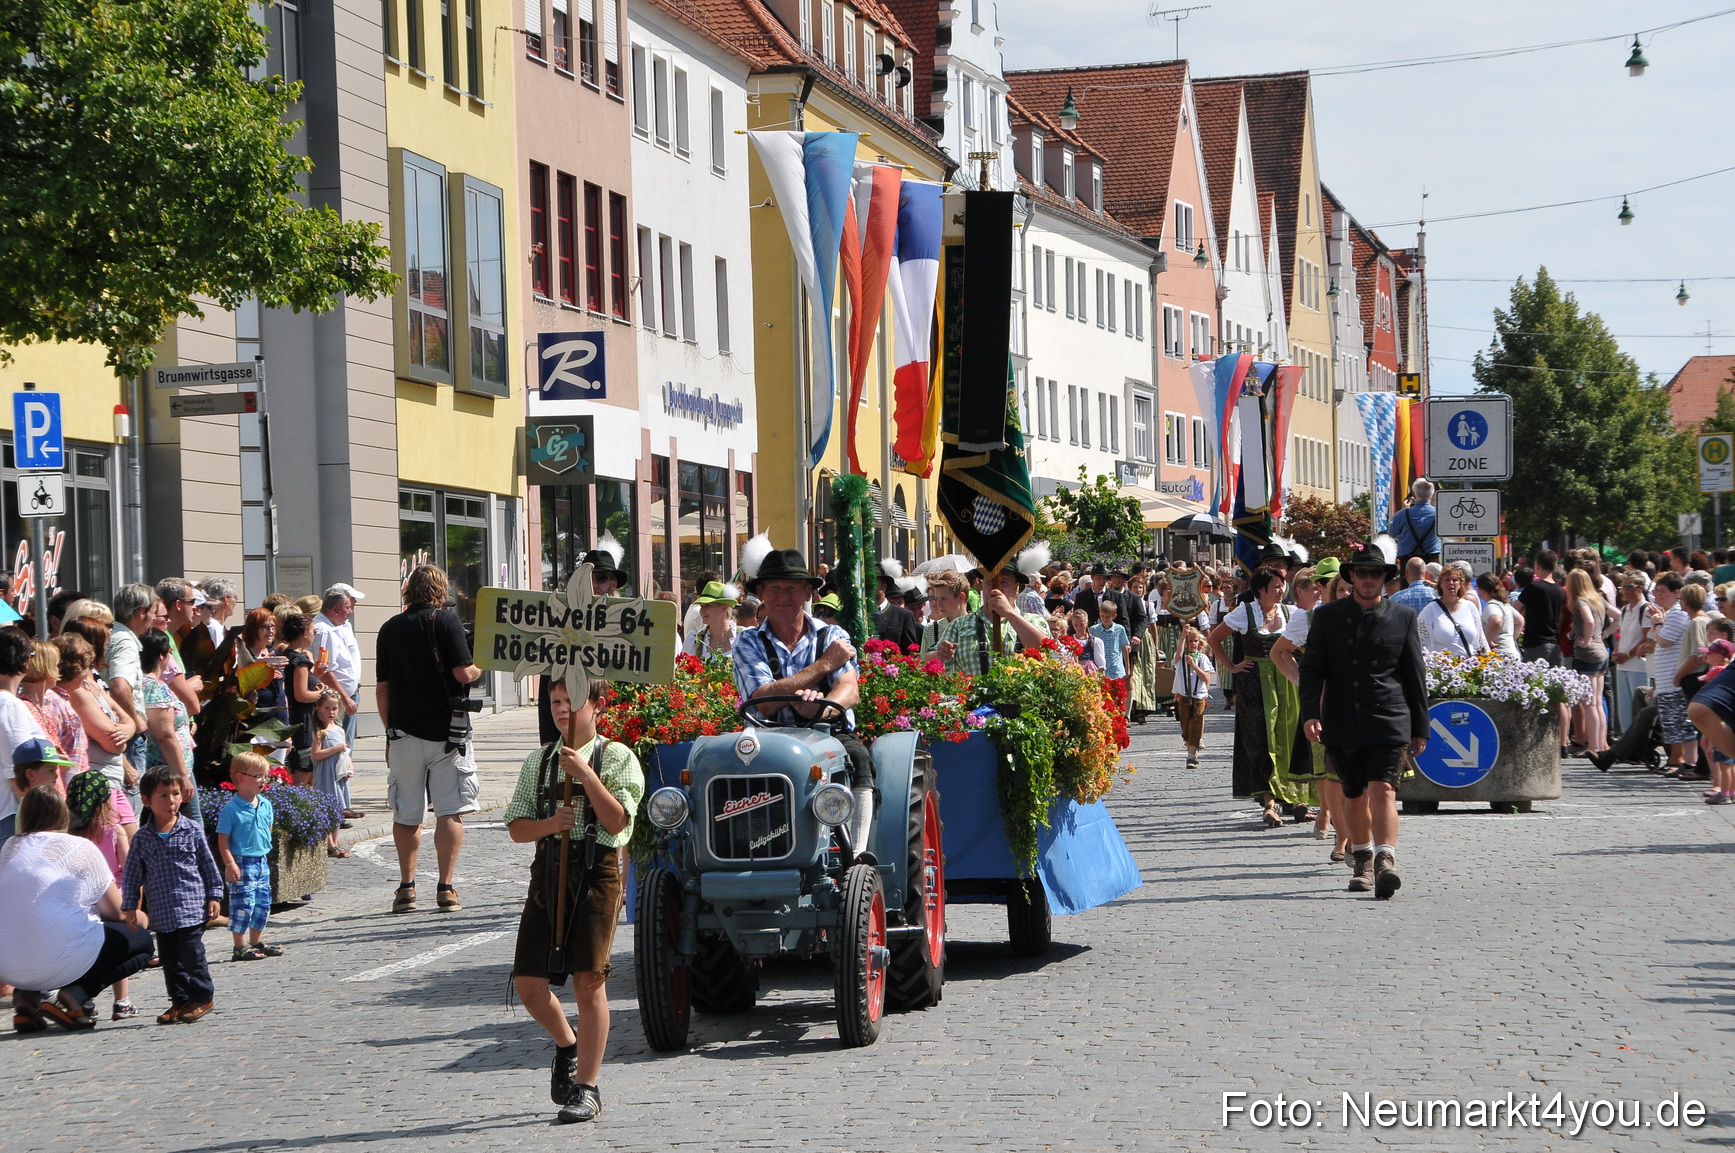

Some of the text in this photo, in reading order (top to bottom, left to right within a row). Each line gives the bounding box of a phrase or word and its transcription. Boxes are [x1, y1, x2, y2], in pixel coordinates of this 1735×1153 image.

[157, 367, 253, 384] Brunnwirtsgasse
[24, 402, 51, 458] P
[546, 434, 569, 462] G2
[1448, 457, 1488, 470] ZONE
[1458, 521, 1478, 531] frei
[1448, 547, 1488, 555] Lieferverkehr
[495, 597, 655, 636] Edelweiß 64
[493, 633, 651, 672] Röckersbühl
[723, 791, 771, 814] Eicher
